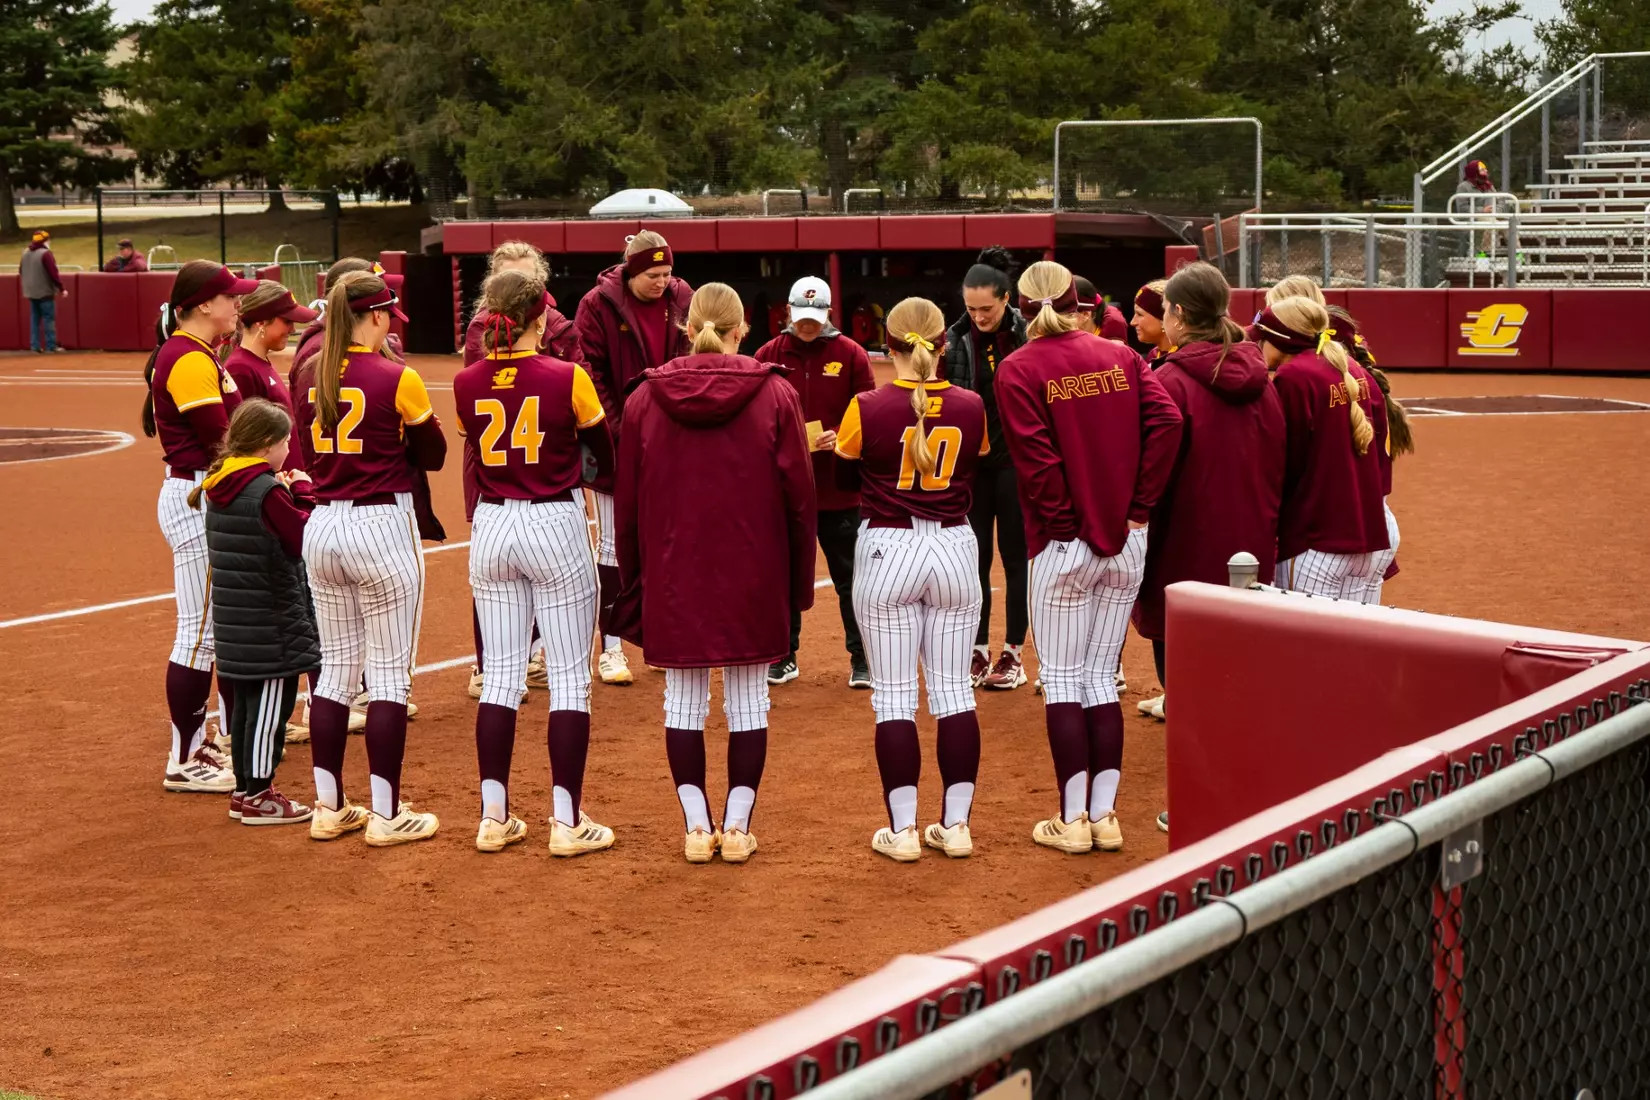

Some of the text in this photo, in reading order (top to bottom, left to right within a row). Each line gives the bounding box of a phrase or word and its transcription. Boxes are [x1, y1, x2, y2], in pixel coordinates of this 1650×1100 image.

[1458, 304, 1529, 356] C
[1047, 364, 1130, 403] ARETÉ
[475, 396, 546, 467] 24
[896, 426, 963, 491] 10
